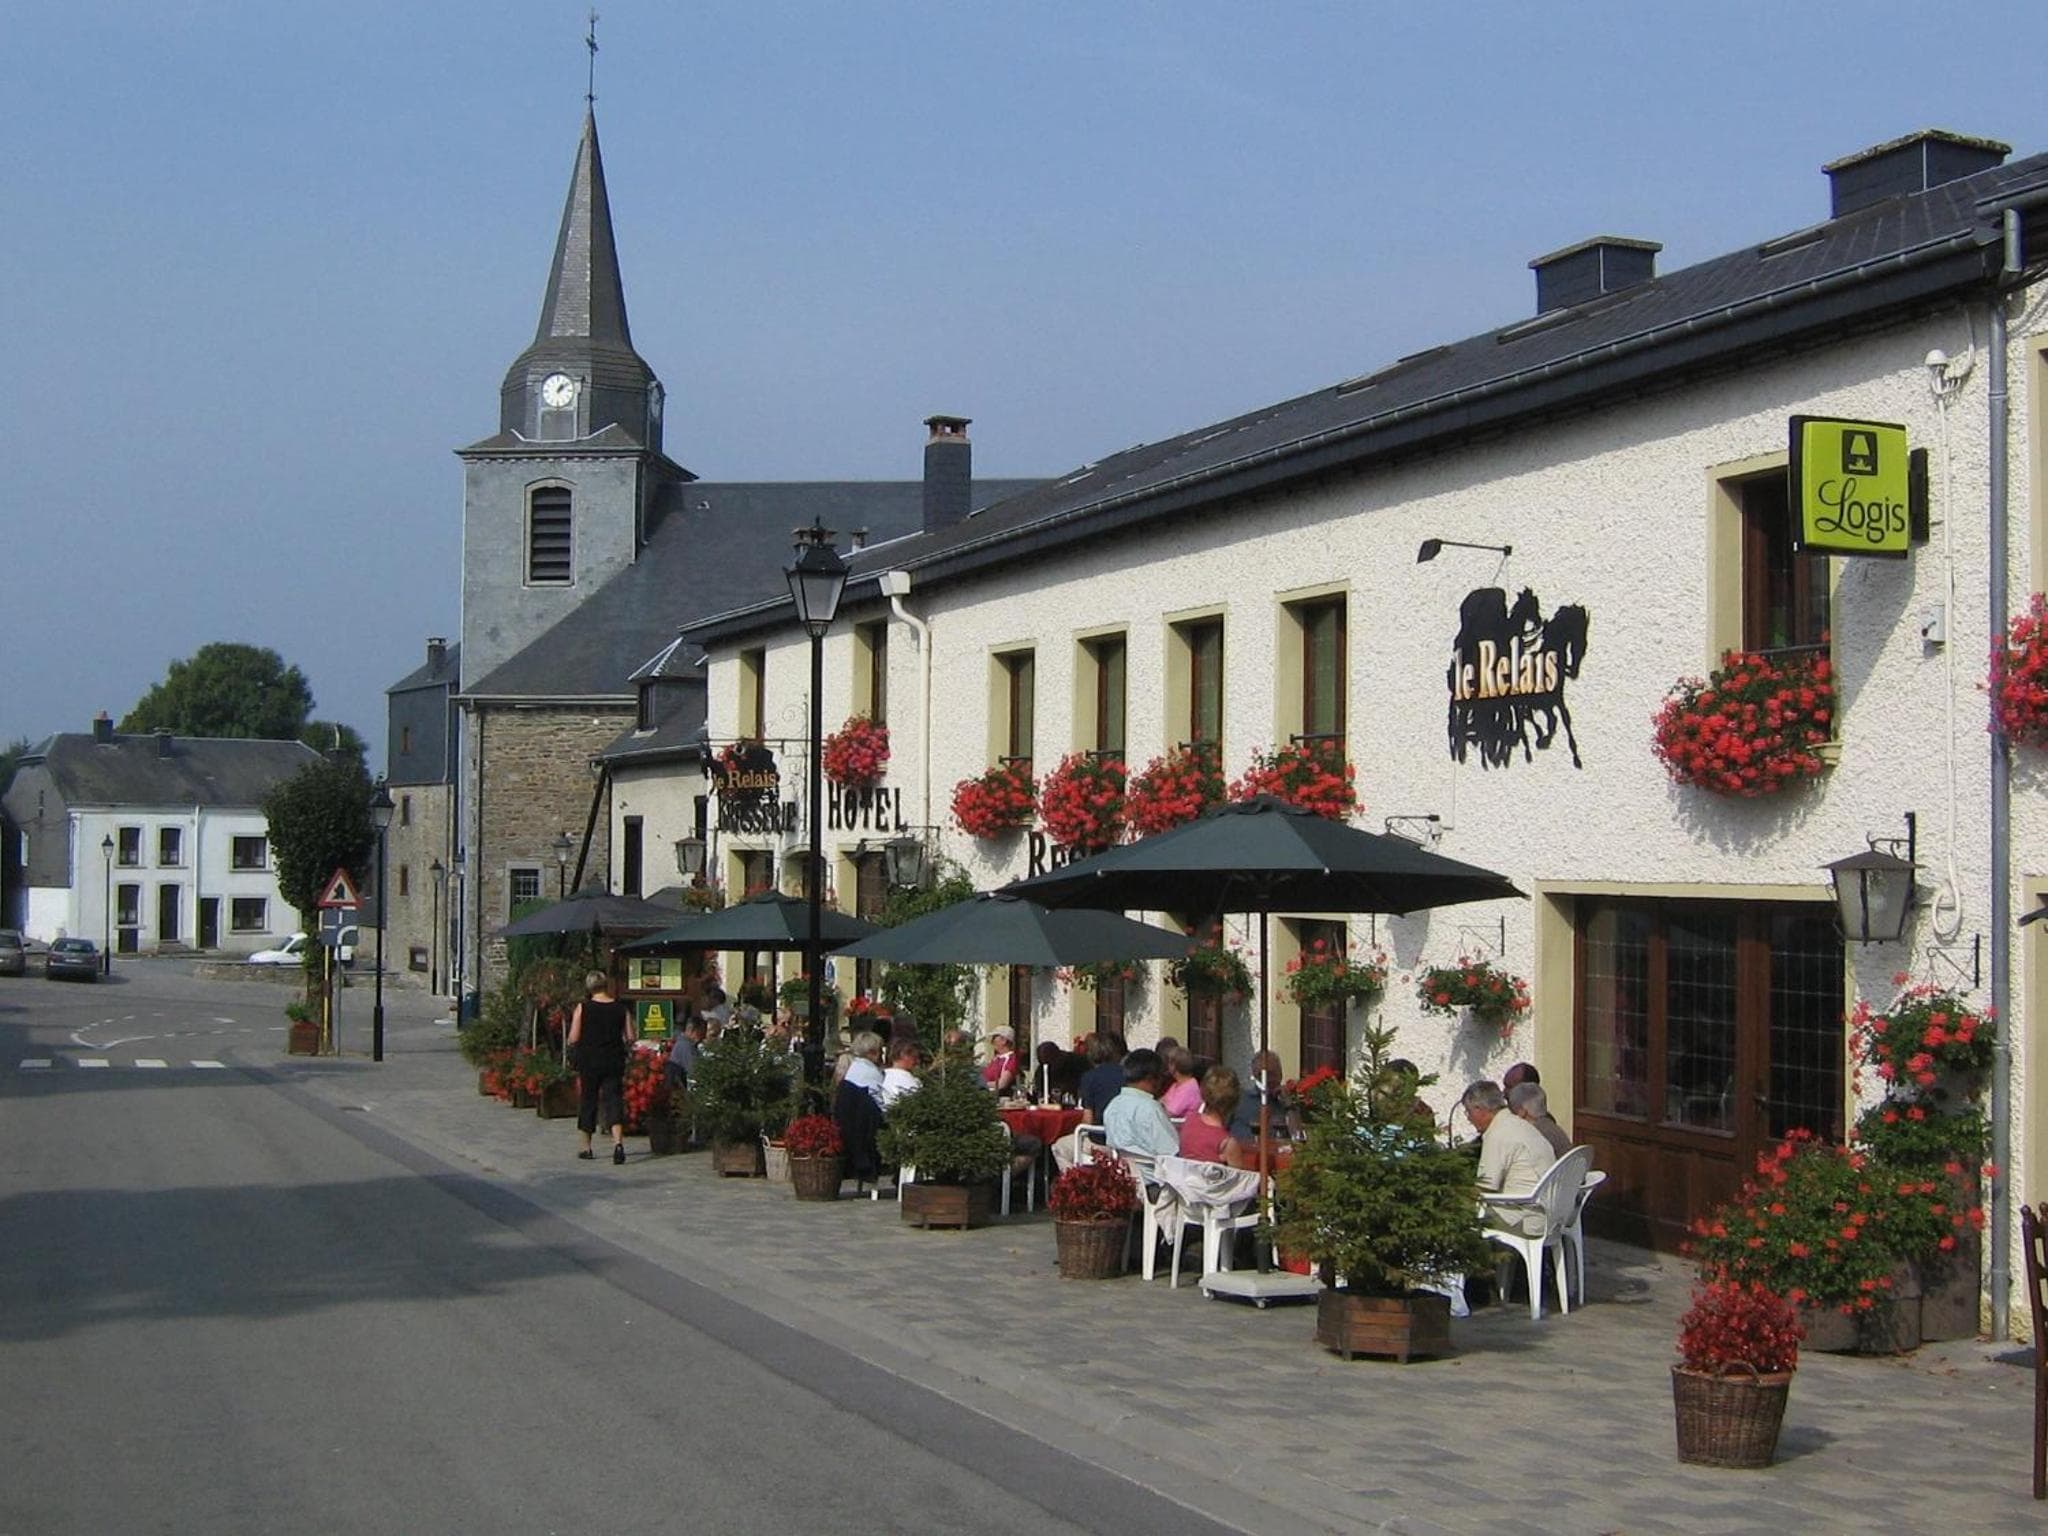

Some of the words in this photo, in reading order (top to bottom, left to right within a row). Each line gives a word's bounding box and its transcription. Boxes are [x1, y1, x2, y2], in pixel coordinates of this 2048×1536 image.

[1815, 477, 1906, 544] Logis
[1453, 647, 1475, 701] le
[1478, 635, 1559, 699] Relais
[727, 769, 777, 788] Relais
